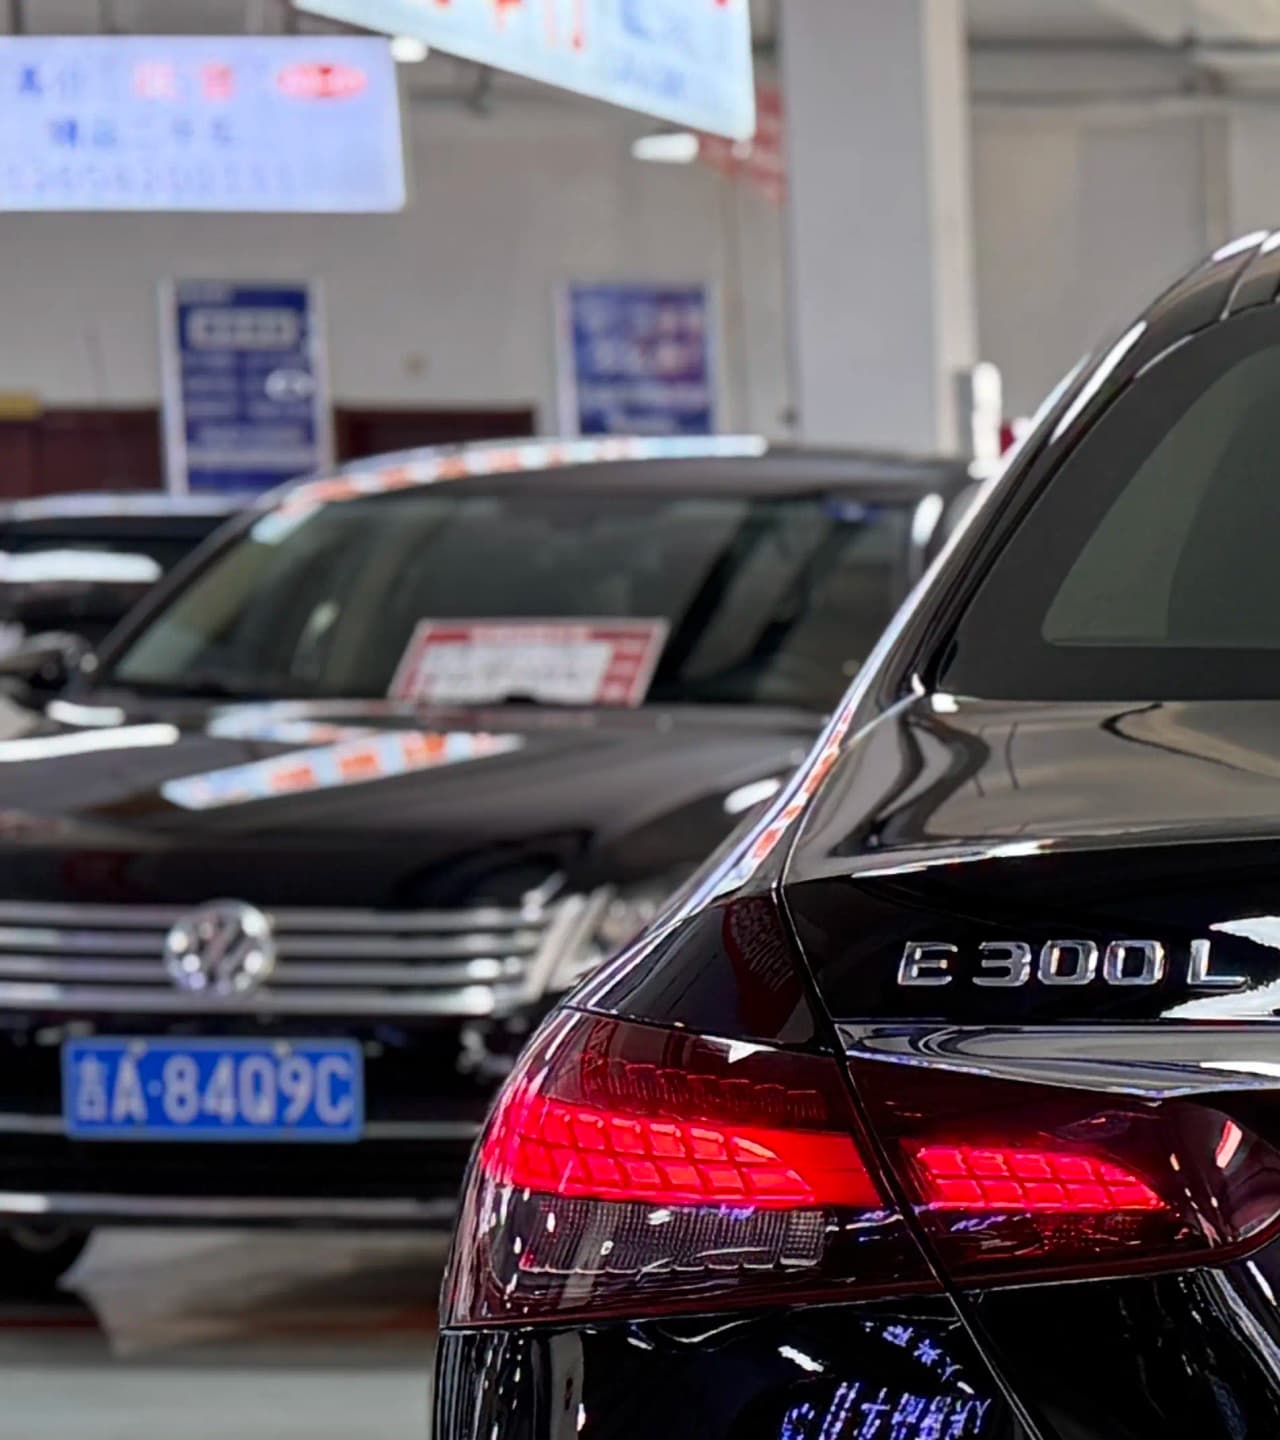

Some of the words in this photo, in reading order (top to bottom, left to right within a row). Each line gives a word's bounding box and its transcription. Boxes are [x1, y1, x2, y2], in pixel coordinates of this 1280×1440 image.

[897, 941, 958, 985] E
[973, 940, 1165, 986] 300
[1187, 938, 1249, 993] L
